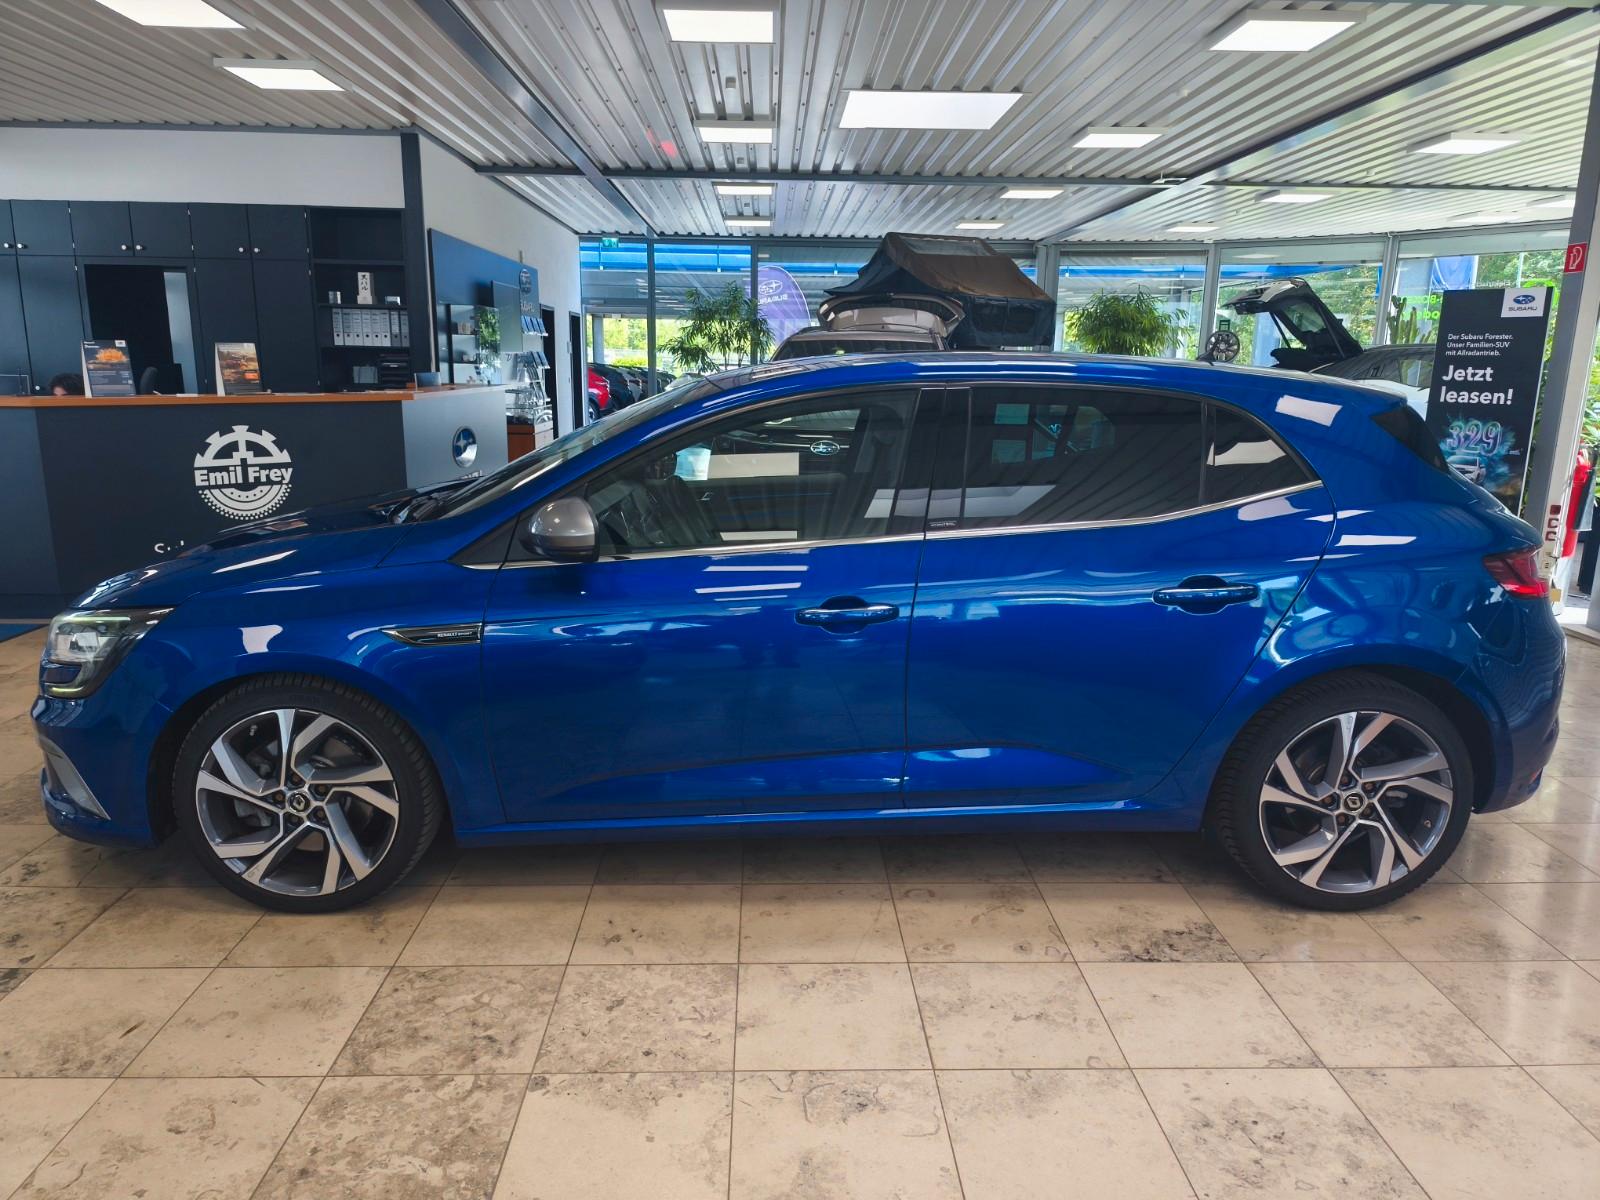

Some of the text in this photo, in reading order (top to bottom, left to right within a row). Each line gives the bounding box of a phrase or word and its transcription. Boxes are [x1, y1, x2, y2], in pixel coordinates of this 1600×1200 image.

[1442, 364, 1494, 382] Jetzt
[1439, 385, 1513, 405] leasen!
[1446, 420, 1502, 456] 329
[194, 465, 293, 487] Emil Frey
